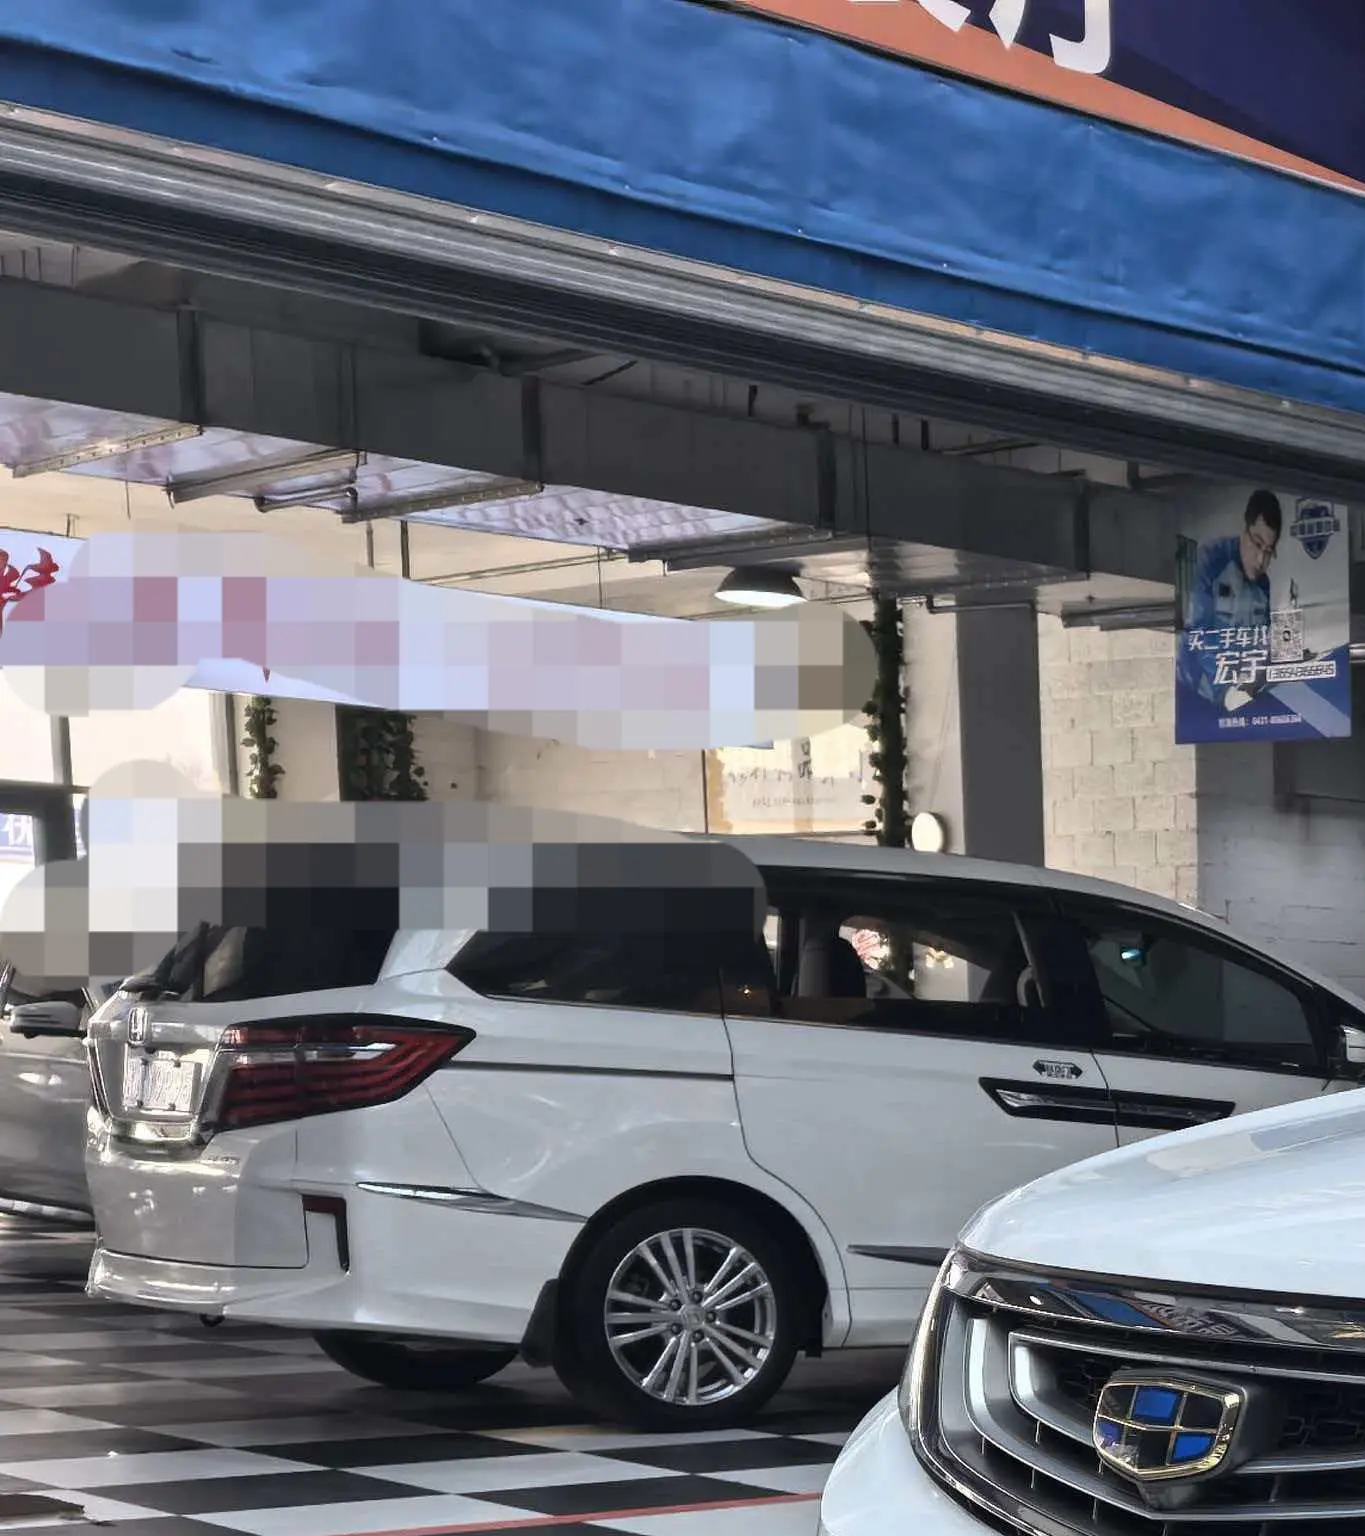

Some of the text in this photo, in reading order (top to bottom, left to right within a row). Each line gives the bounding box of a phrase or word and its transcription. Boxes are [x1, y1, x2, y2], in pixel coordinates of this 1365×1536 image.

[1188, 625, 1269, 651] 买二手车找
[1213, 649, 1269, 685] 宏宇
